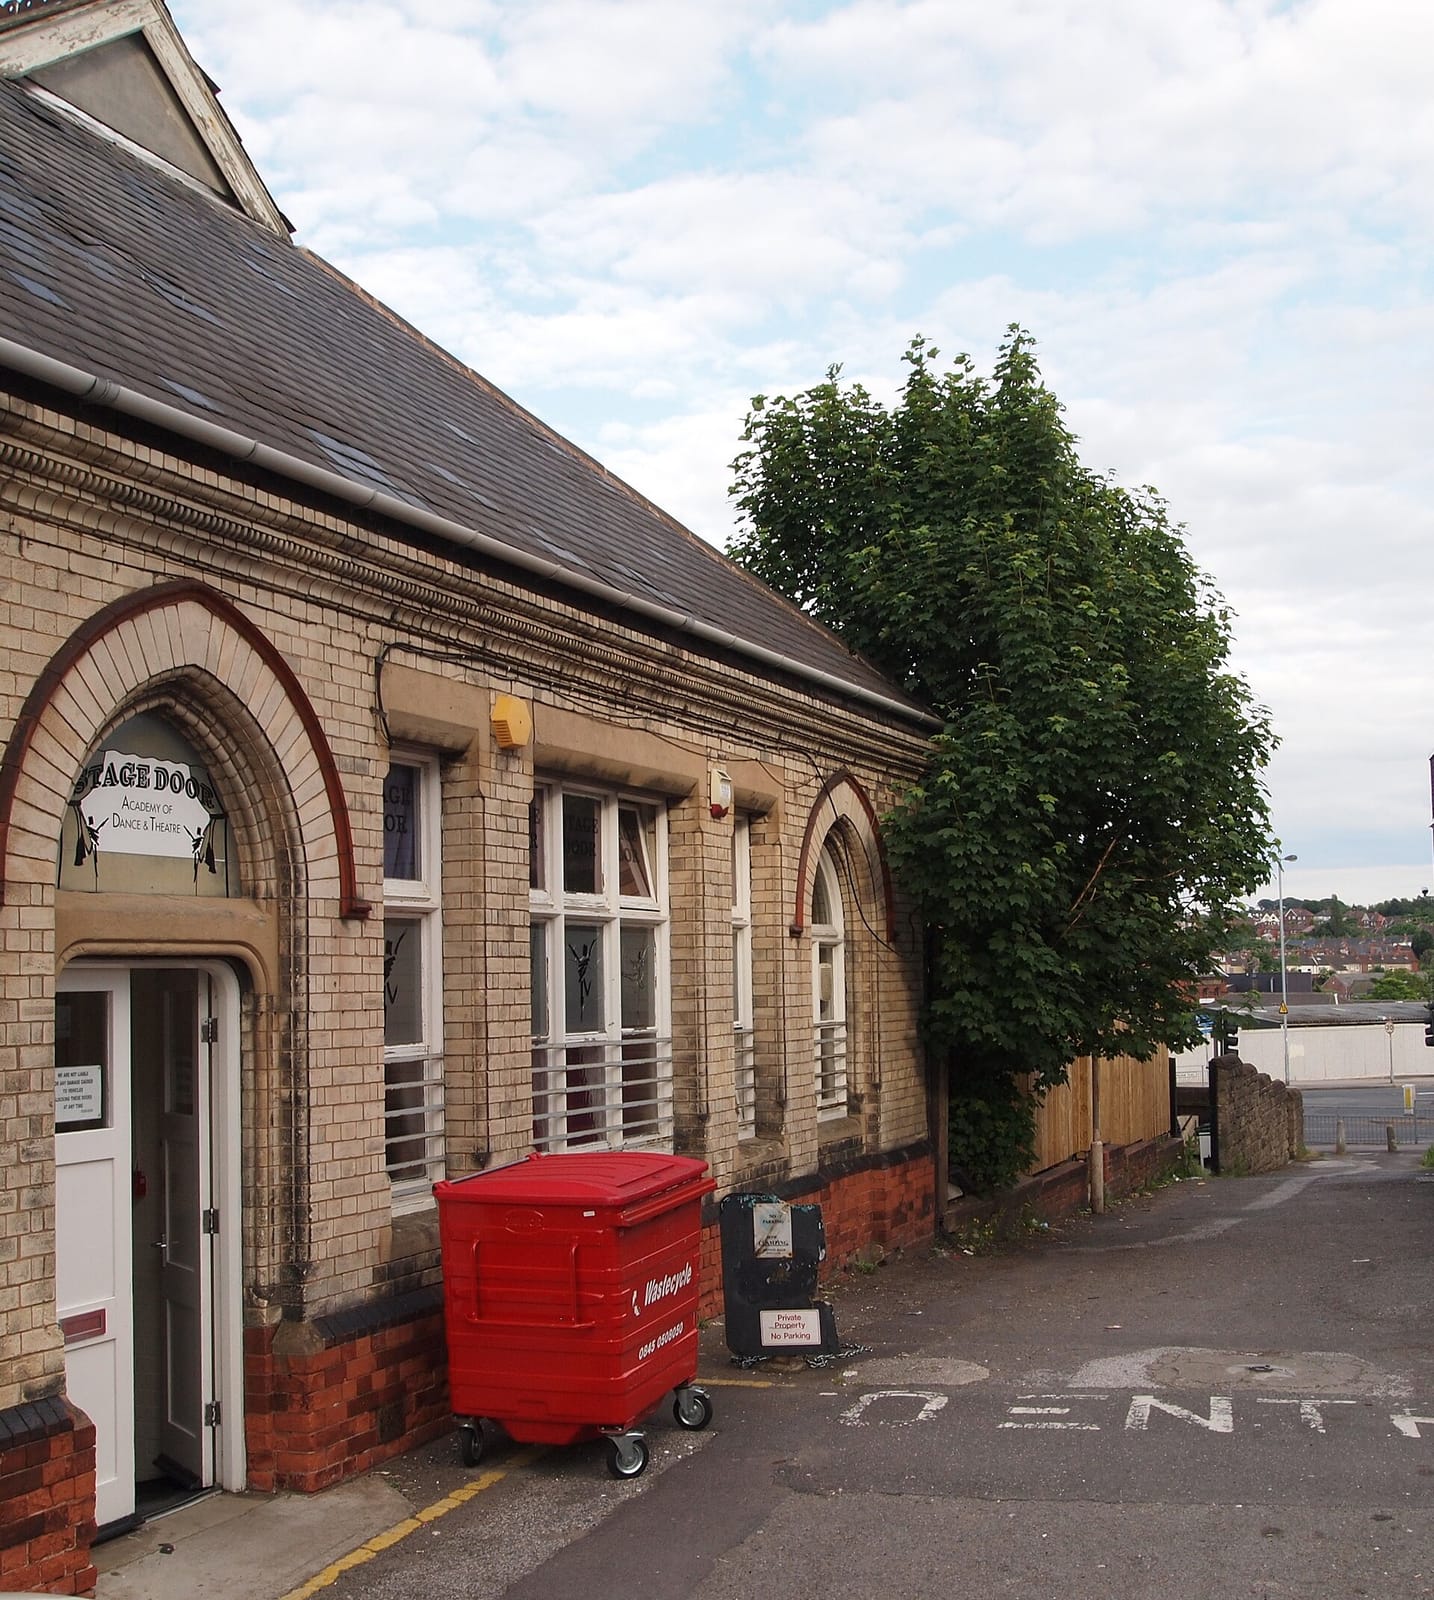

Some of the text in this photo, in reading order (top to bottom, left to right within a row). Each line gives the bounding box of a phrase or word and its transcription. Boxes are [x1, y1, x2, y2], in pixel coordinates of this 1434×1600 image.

[74, 762, 215, 809] STAGE DOOR
[121, 795, 173, 814] ACADEMY OF
[112, 812, 181, 834] DANCE & THEATRE
[644, 1261, 692, 1307] Wastecycle
[774, 1321, 806, 1329] Property
[777, 1313, 802, 1321] Private
[771, 1331, 811, 1340] No Parking
[638, 1339, 656, 1361] 0845
